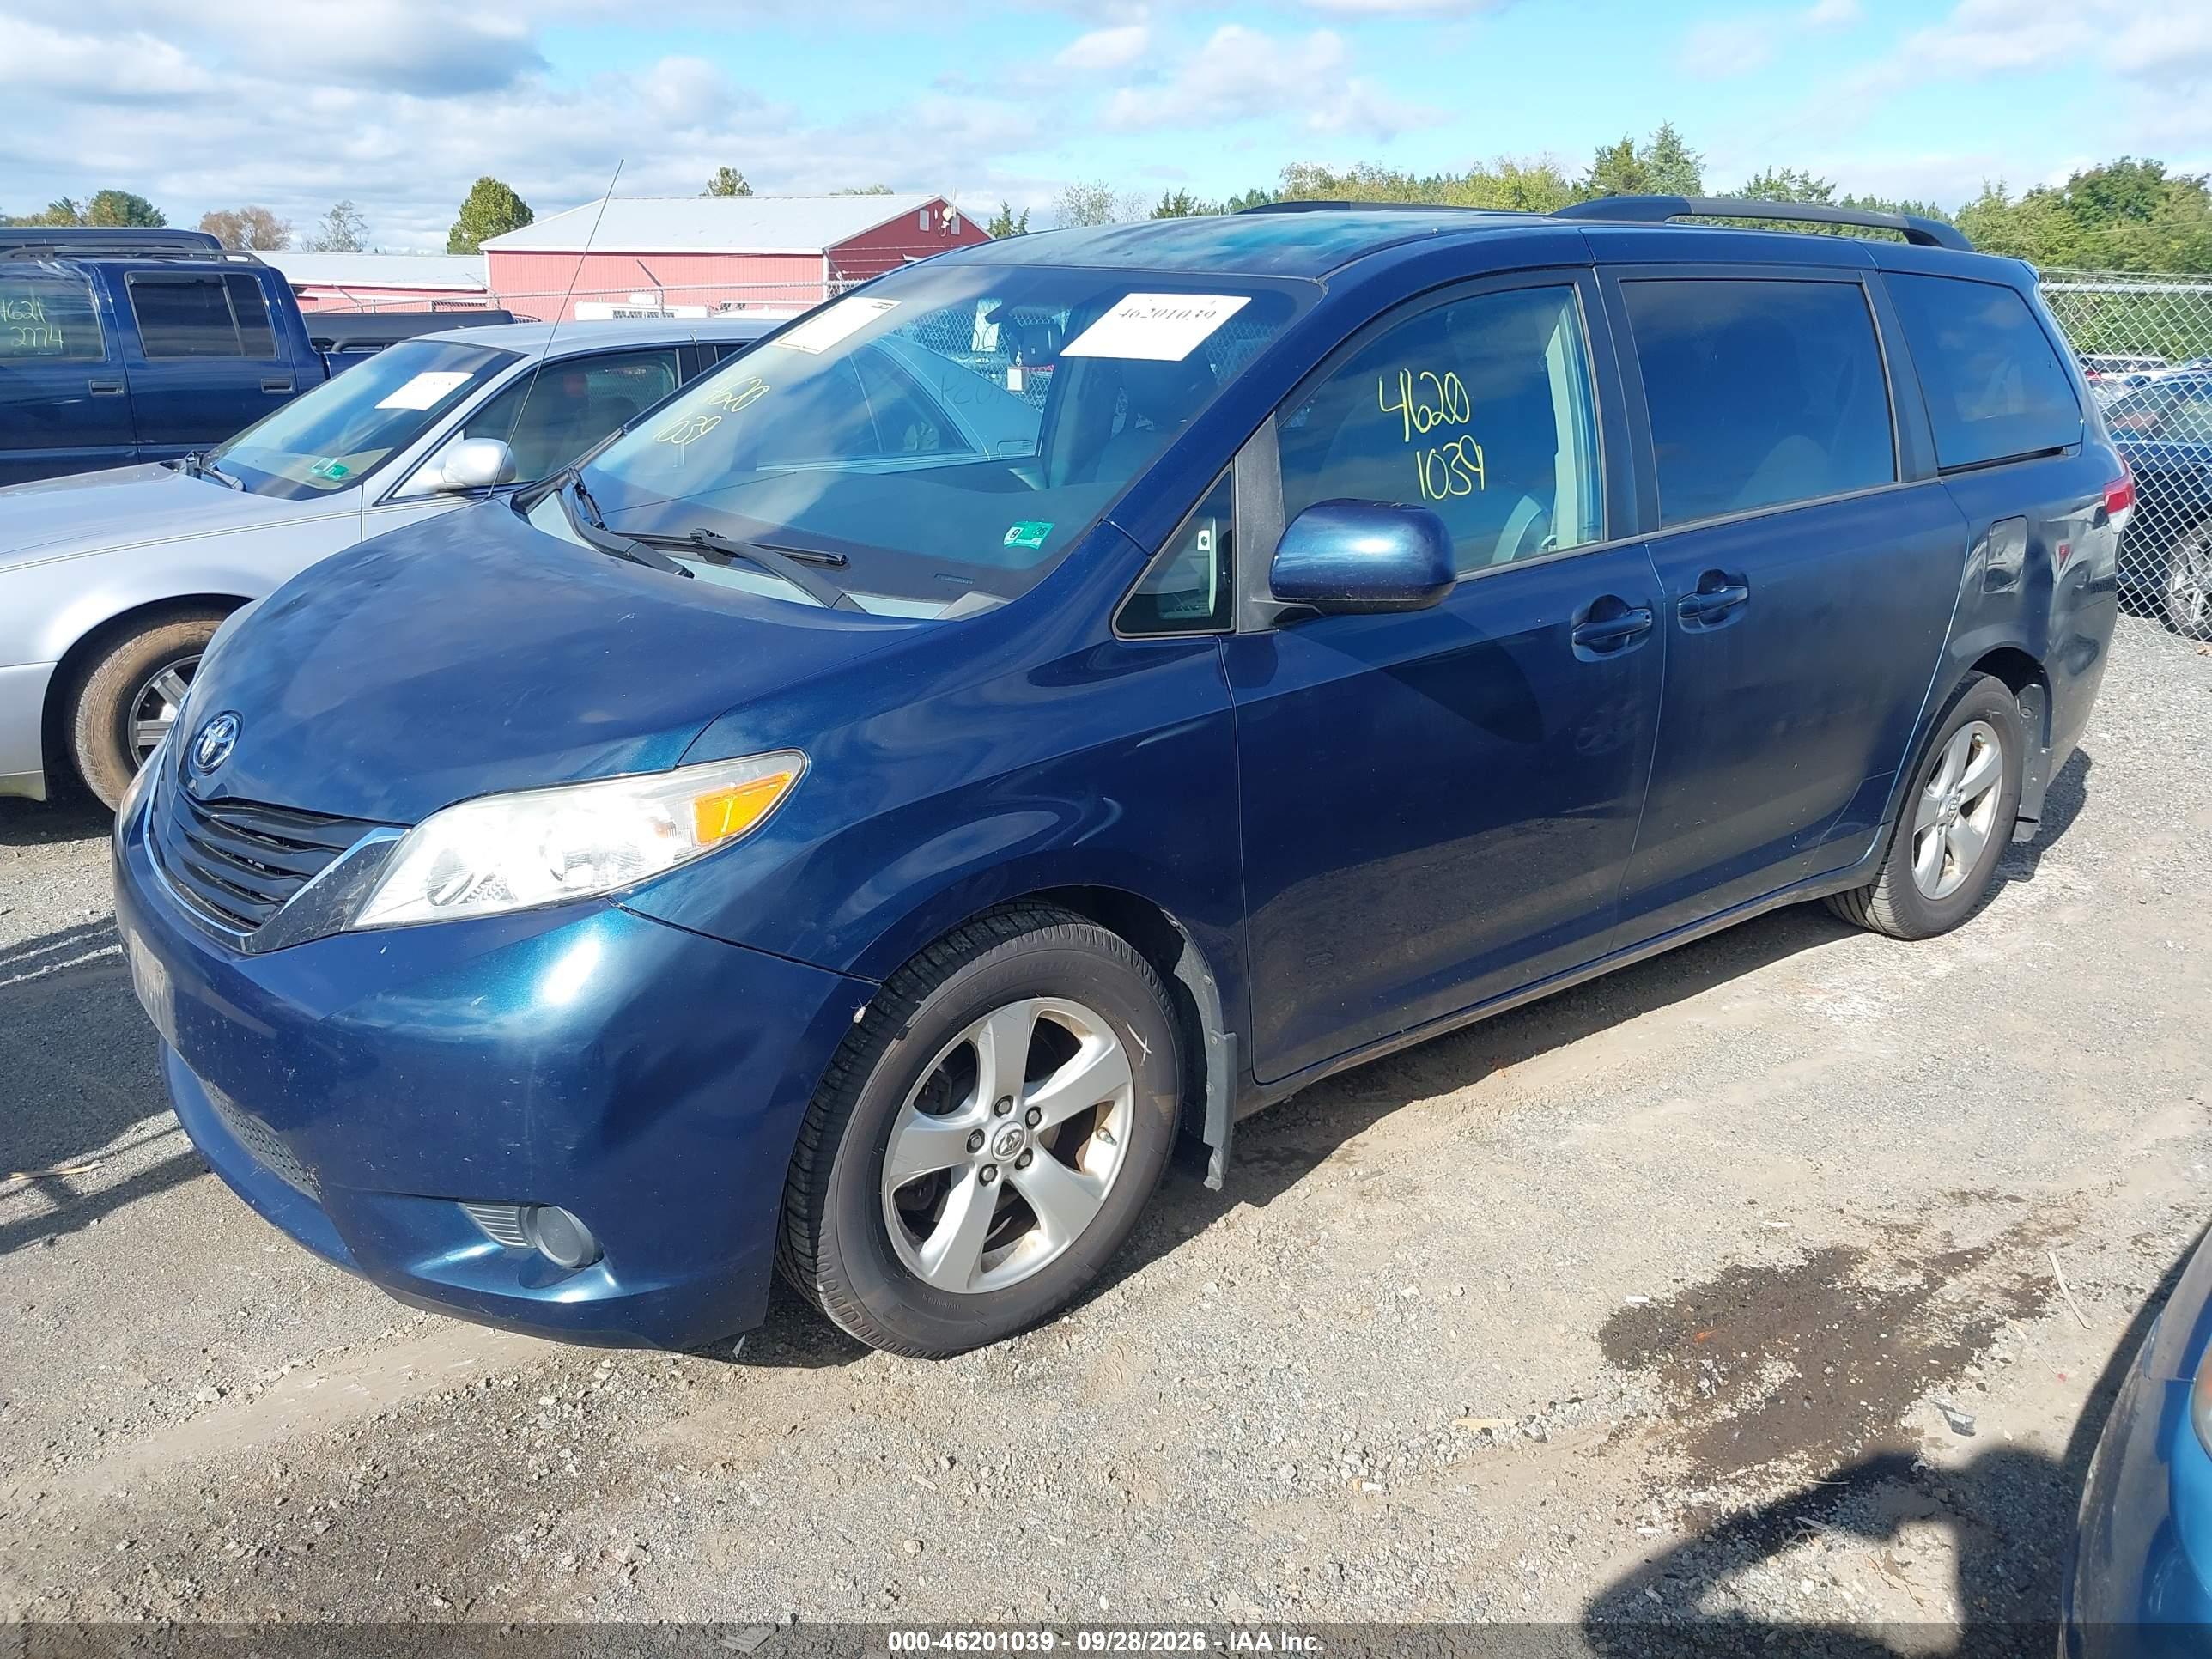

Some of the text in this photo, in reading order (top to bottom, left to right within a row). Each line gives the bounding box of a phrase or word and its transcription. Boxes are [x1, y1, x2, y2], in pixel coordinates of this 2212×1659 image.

[10, 325, 64, 349] 2774
[1379, 368, 1470, 442] 4620
[1417, 434, 1485, 500] 1039
